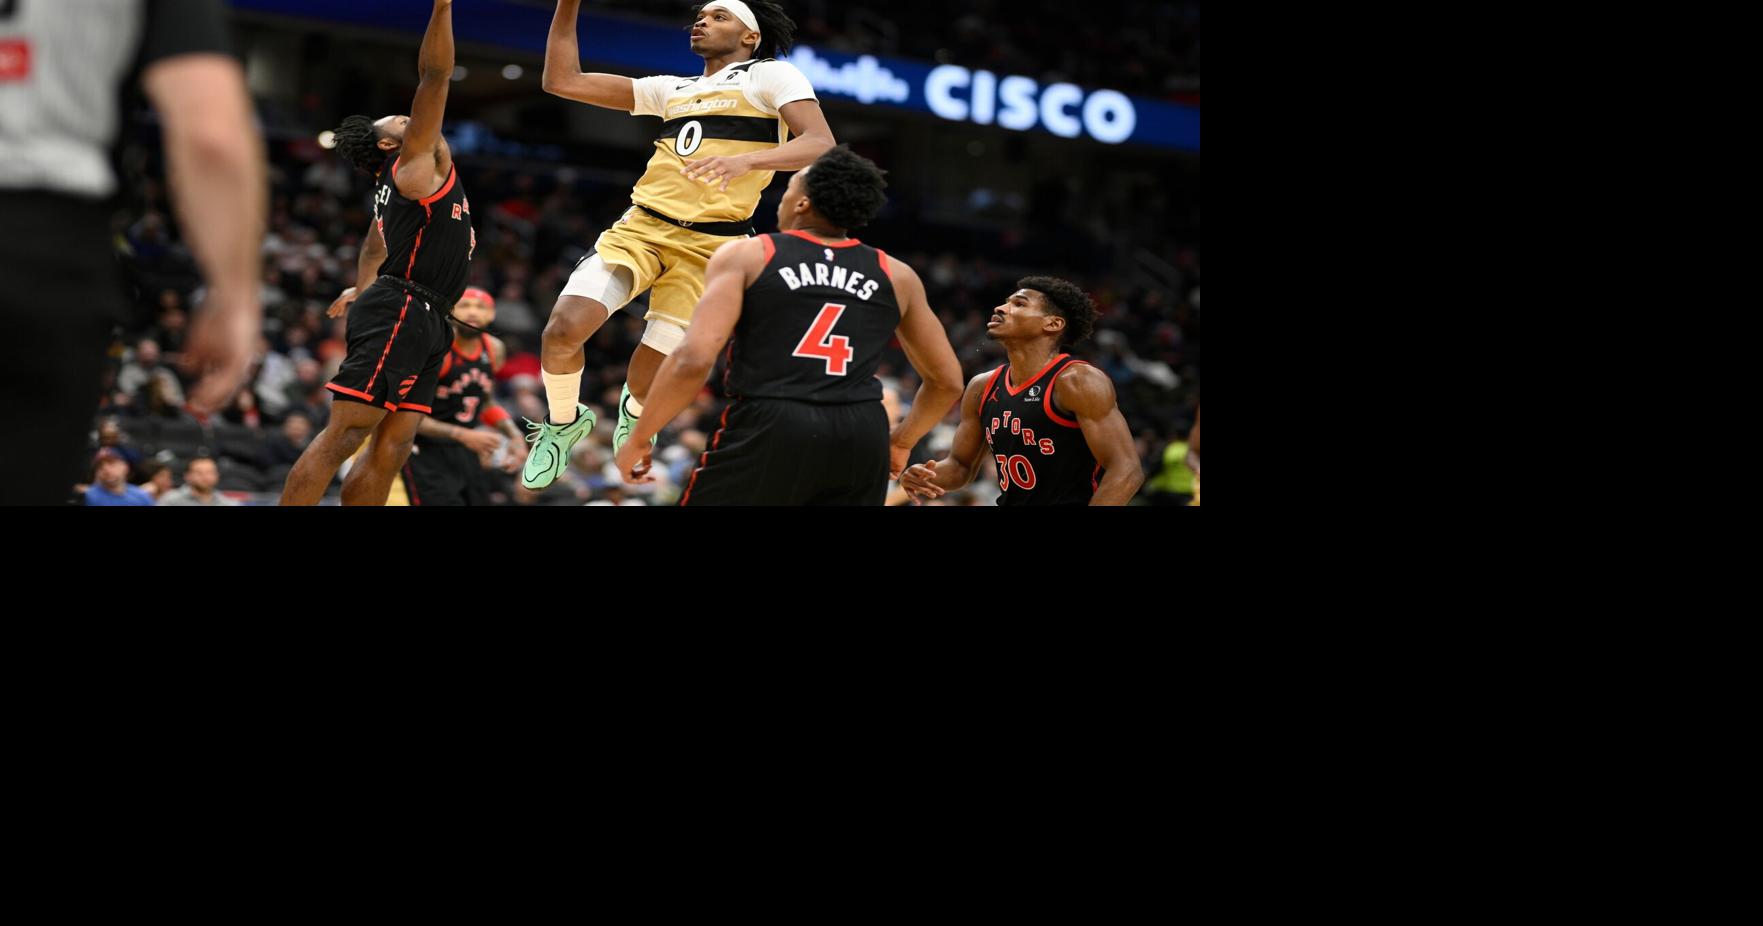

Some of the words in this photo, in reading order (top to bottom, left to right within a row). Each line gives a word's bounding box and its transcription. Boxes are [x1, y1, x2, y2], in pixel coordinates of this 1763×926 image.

[924, 64, 1136, 145] CISCO
[675, 120, 703, 157] 0
[778, 262, 879, 301] BARNES
[791, 302, 854, 377] 4
[454, 396, 480, 423] 3
[995, 454, 1037, 492] 30
